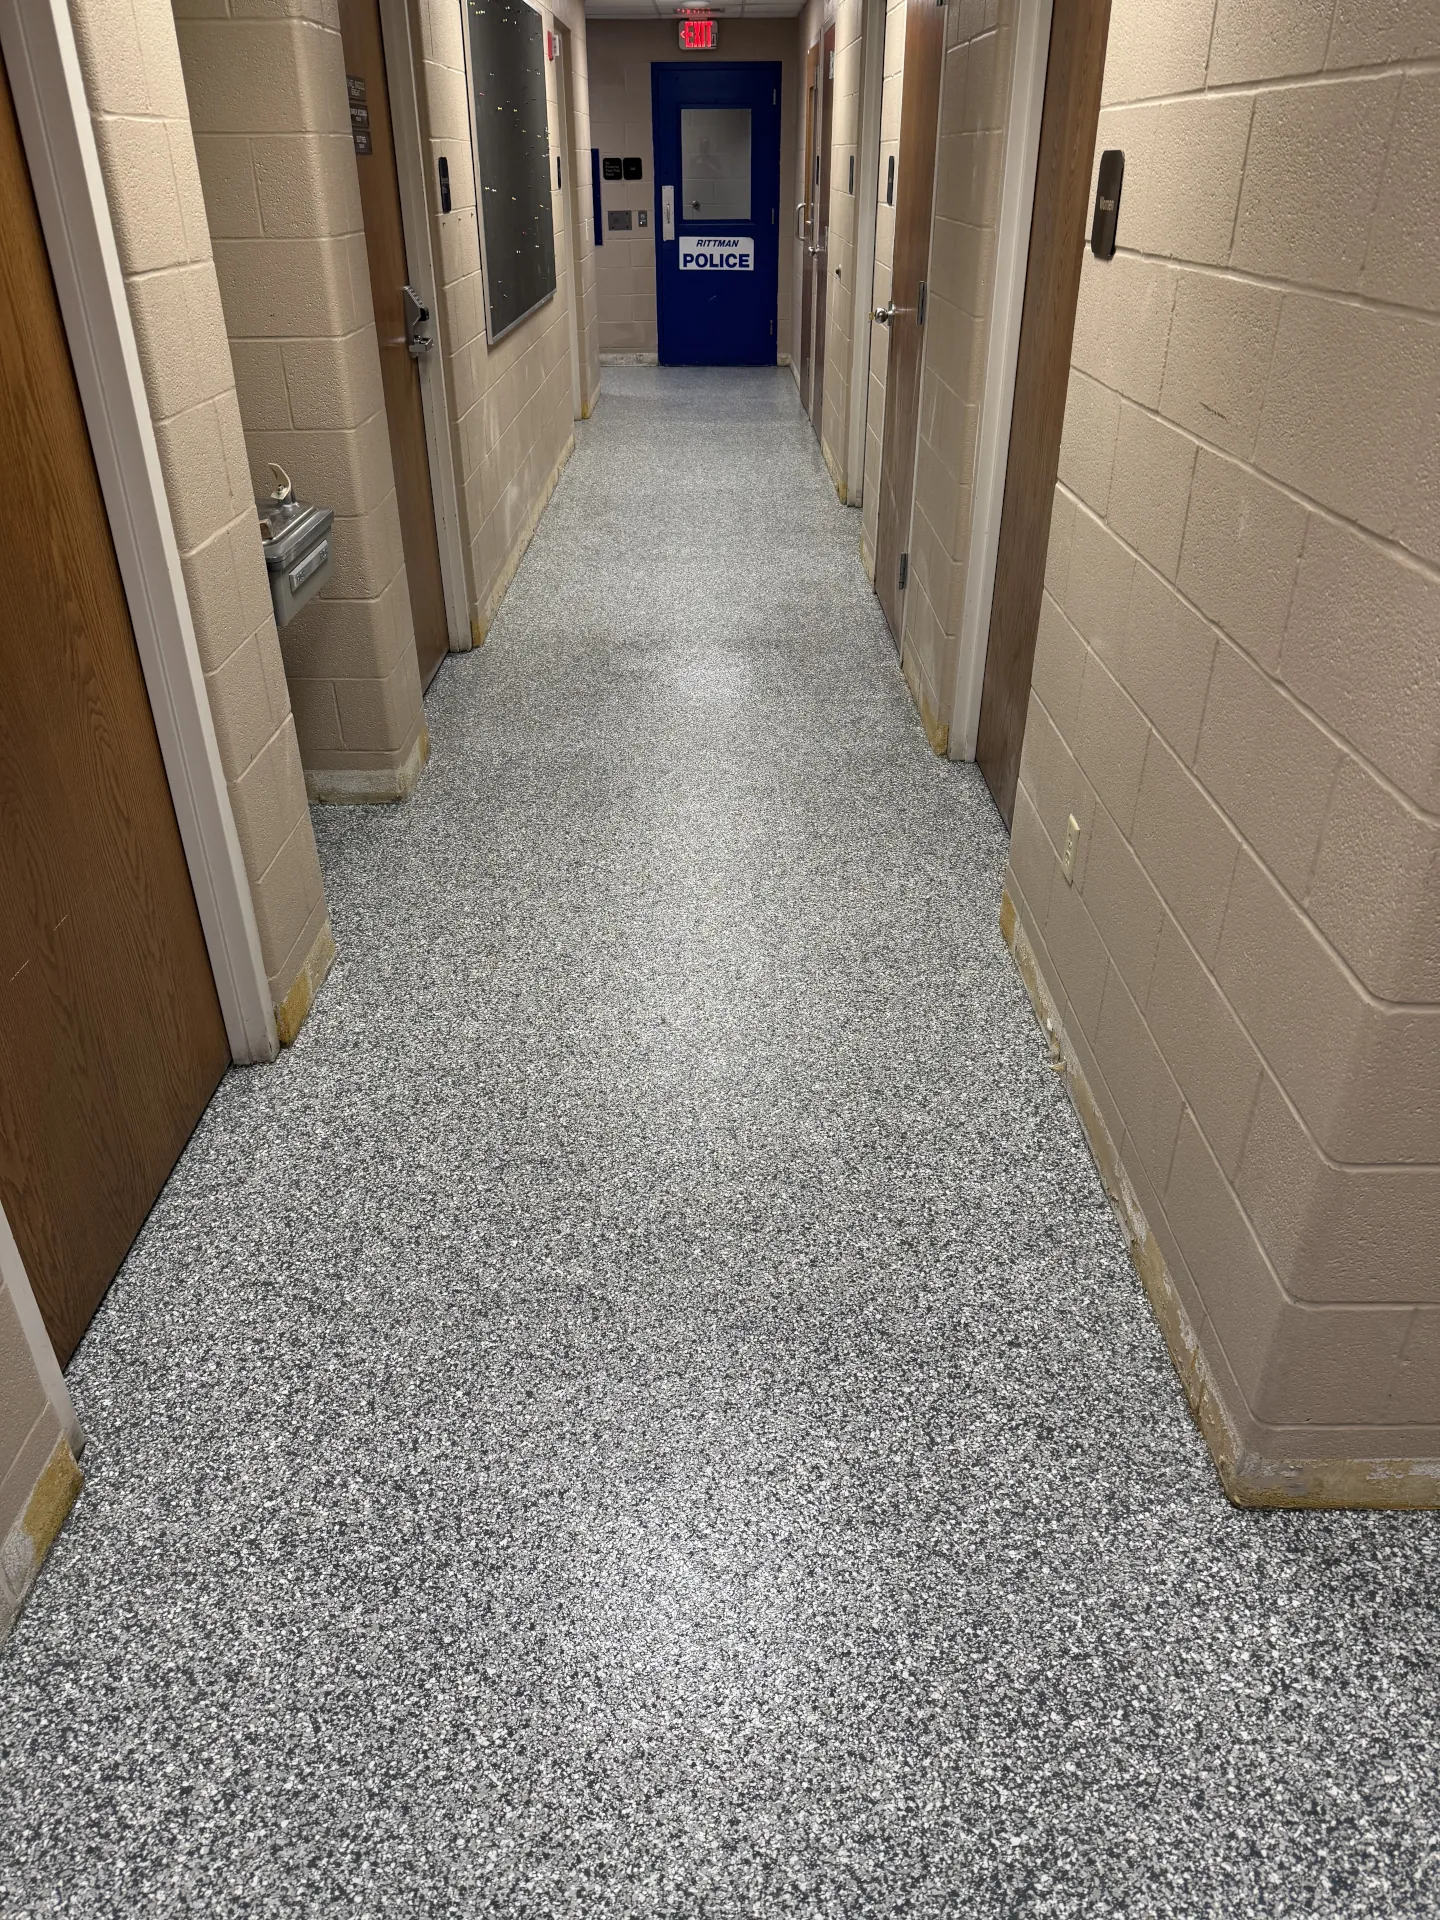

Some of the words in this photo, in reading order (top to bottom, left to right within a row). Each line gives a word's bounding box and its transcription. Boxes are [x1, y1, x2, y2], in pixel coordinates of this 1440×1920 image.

[685, 21, 713, 48] EXIT
[1099, 196, 1114, 211] Women
[696, 239, 739, 248] RITTMAN
[683, 253, 750, 269] POLICE
